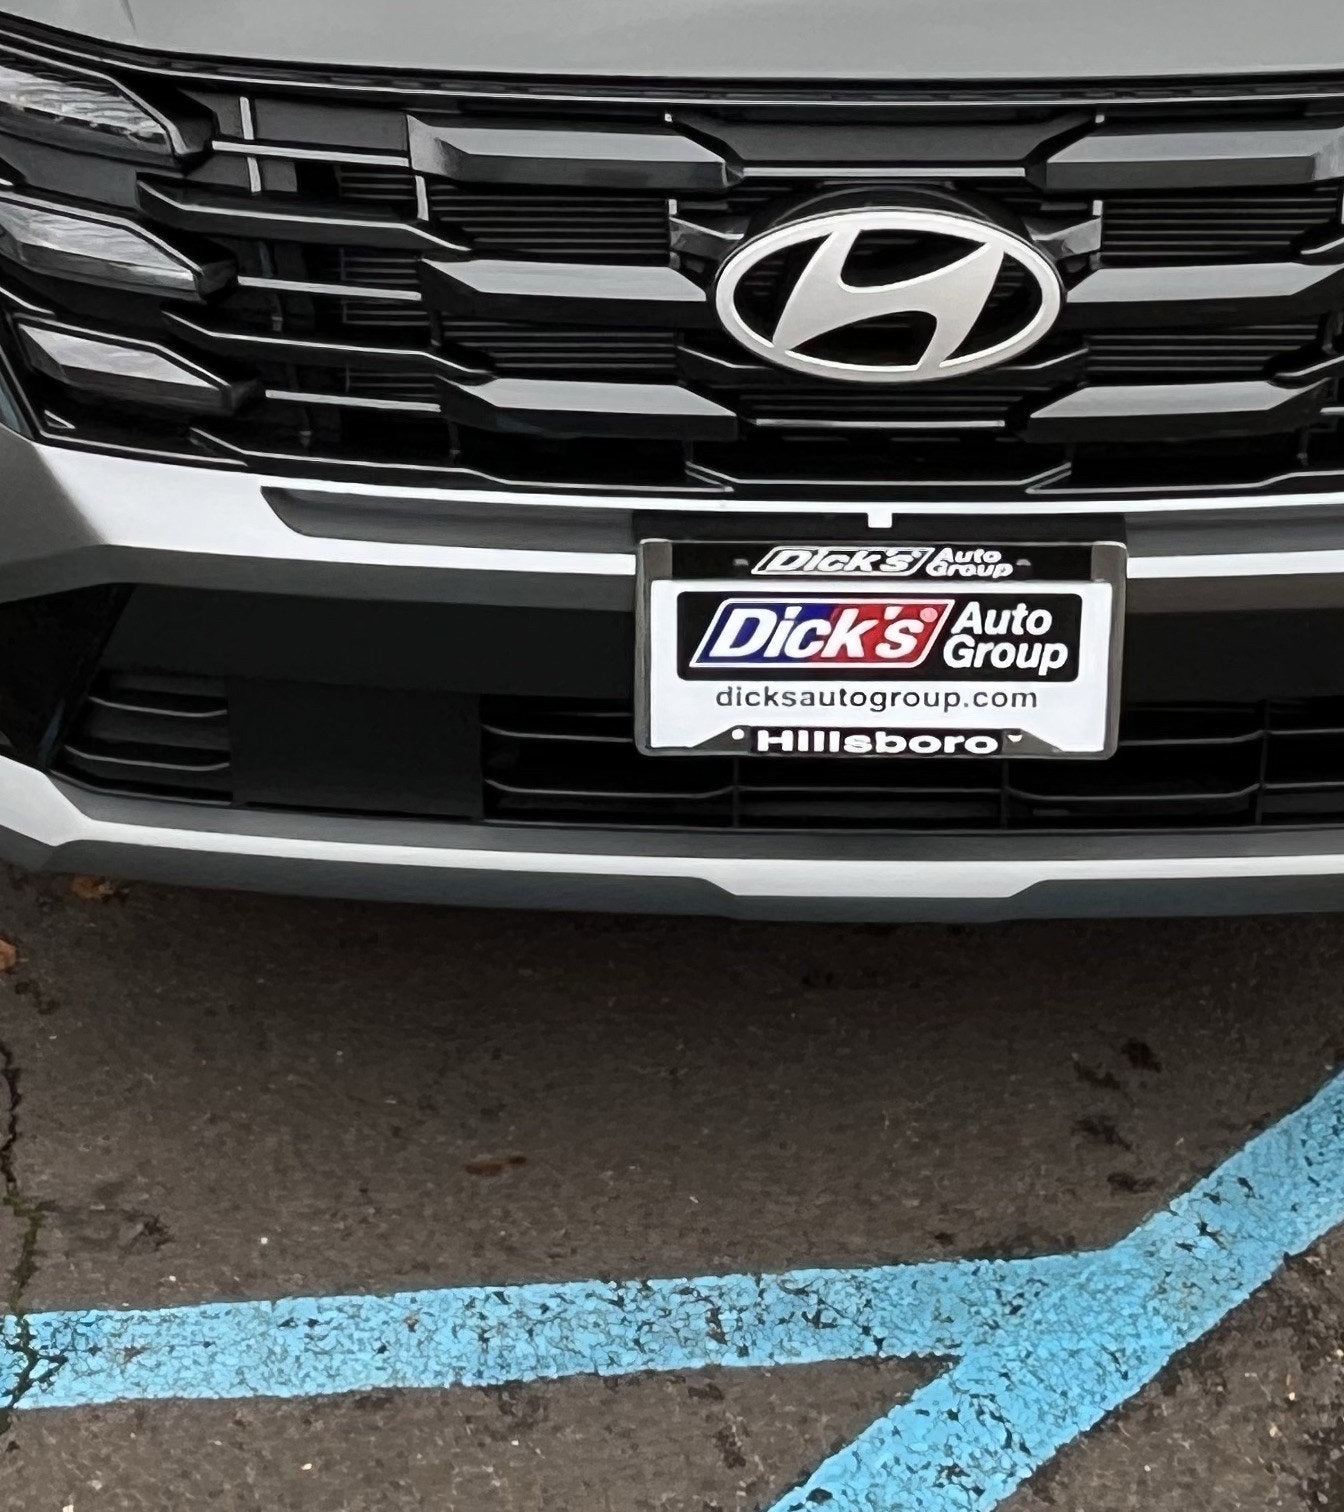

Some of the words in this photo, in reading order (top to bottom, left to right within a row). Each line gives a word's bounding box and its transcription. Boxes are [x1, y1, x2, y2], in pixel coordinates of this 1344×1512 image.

[935, 548, 1002, 564] Auto
[925, 562, 1014, 579] Group
[708, 605, 925, 659] Dick's
[951, 601, 1053, 636] Auto
[943, 635, 1069, 676] Group
[716, 686, 1037, 713] dicksautogroup.com
[757, 730, 999, 754] Hillsboro
